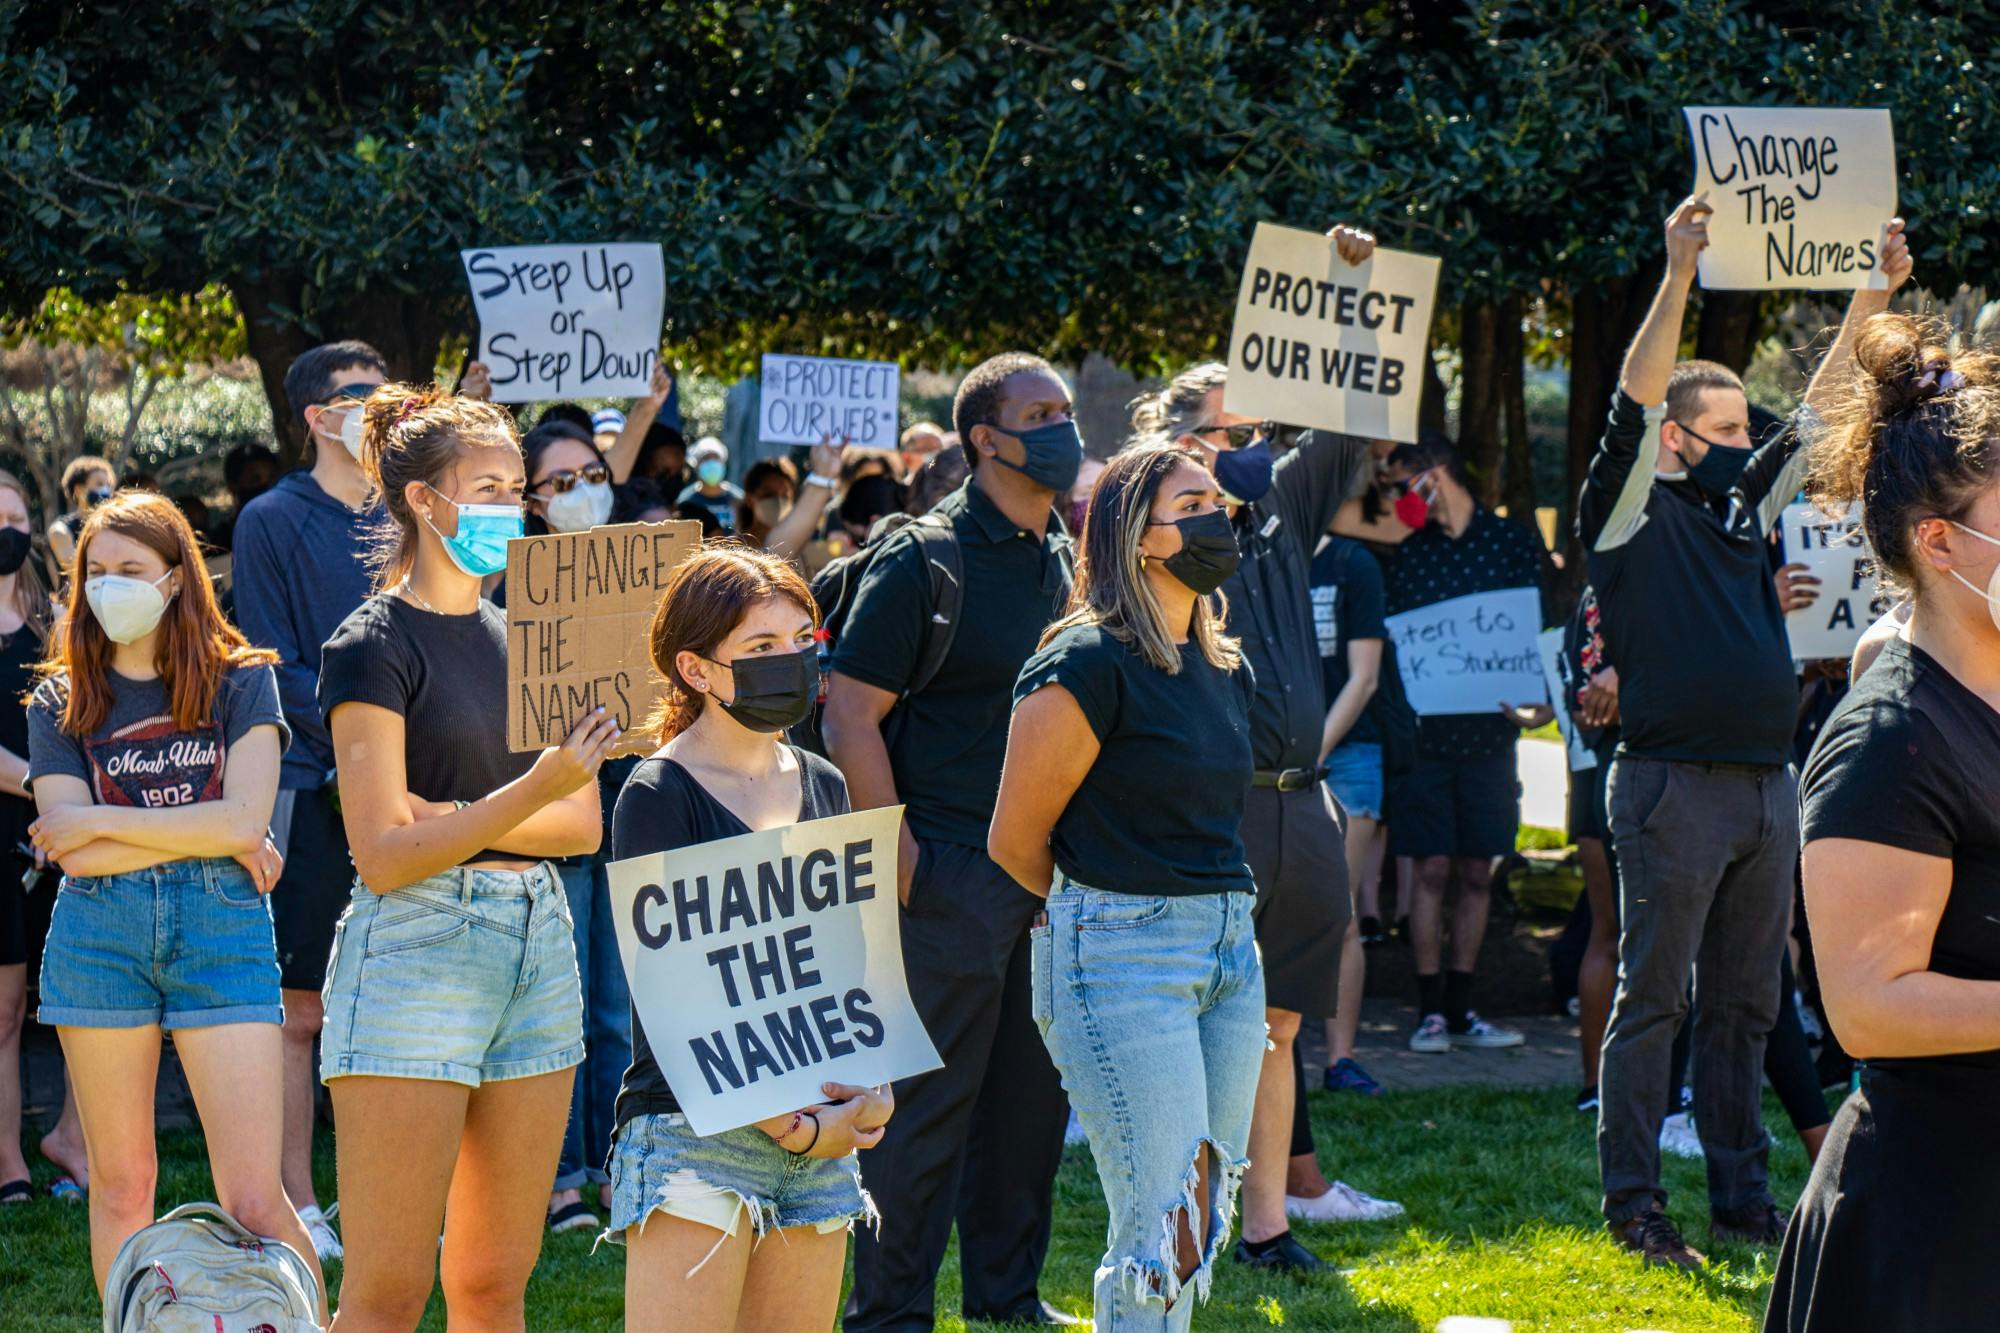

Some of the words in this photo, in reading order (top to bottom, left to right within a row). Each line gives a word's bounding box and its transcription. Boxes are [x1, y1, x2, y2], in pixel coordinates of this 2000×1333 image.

[1700, 113, 1839, 201] Change
[1736, 184, 1796, 225] The
[469, 252, 571, 304] Step
[582, 248, 633, 310] Up
[1767, 223, 1877, 282] Names
[551, 309, 584, 334] or
[1249, 267, 1415, 335] PROTECT
[488, 332, 571, 393] Step
[580, 328, 656, 385] Down
[784, 360, 894, 399] PROTECT
[1241, 332, 1311, 381] OUR
[1321, 347, 1405, 397] WEB
[768, 398, 826, 438] OUR
[829, 405, 877, 443] WEB
[525, 533, 675, 605] CHANGE
[513, 614, 574, 677] THE
[1401, 618, 1458, 646] ten
[1469, 605, 1515, 634] to
[1437, 642, 1544, 676] Students
[141, 783, 194, 807] 1902
[632, 839, 876, 950] CHANGE
[706, 925, 822, 1007] THE
[688, 988, 885, 1095] NAMES
